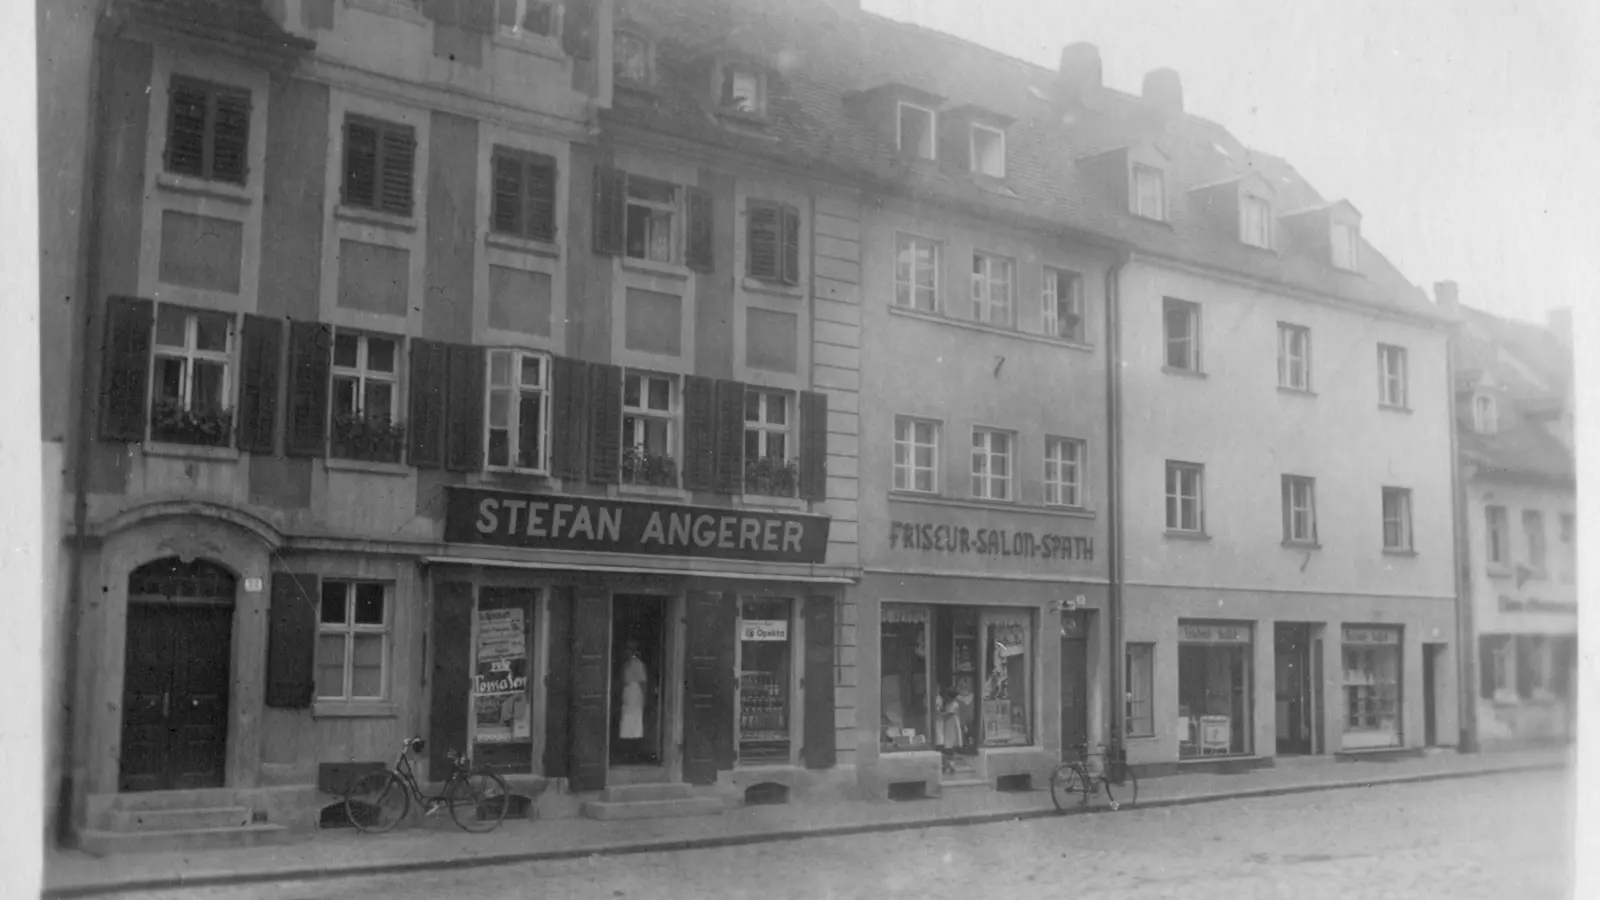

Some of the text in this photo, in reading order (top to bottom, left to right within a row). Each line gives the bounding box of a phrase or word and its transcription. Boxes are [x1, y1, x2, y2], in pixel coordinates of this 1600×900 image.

[476, 497, 804, 552] STEFAN ANGERER
[474, 672, 528, 693] Tomaten
